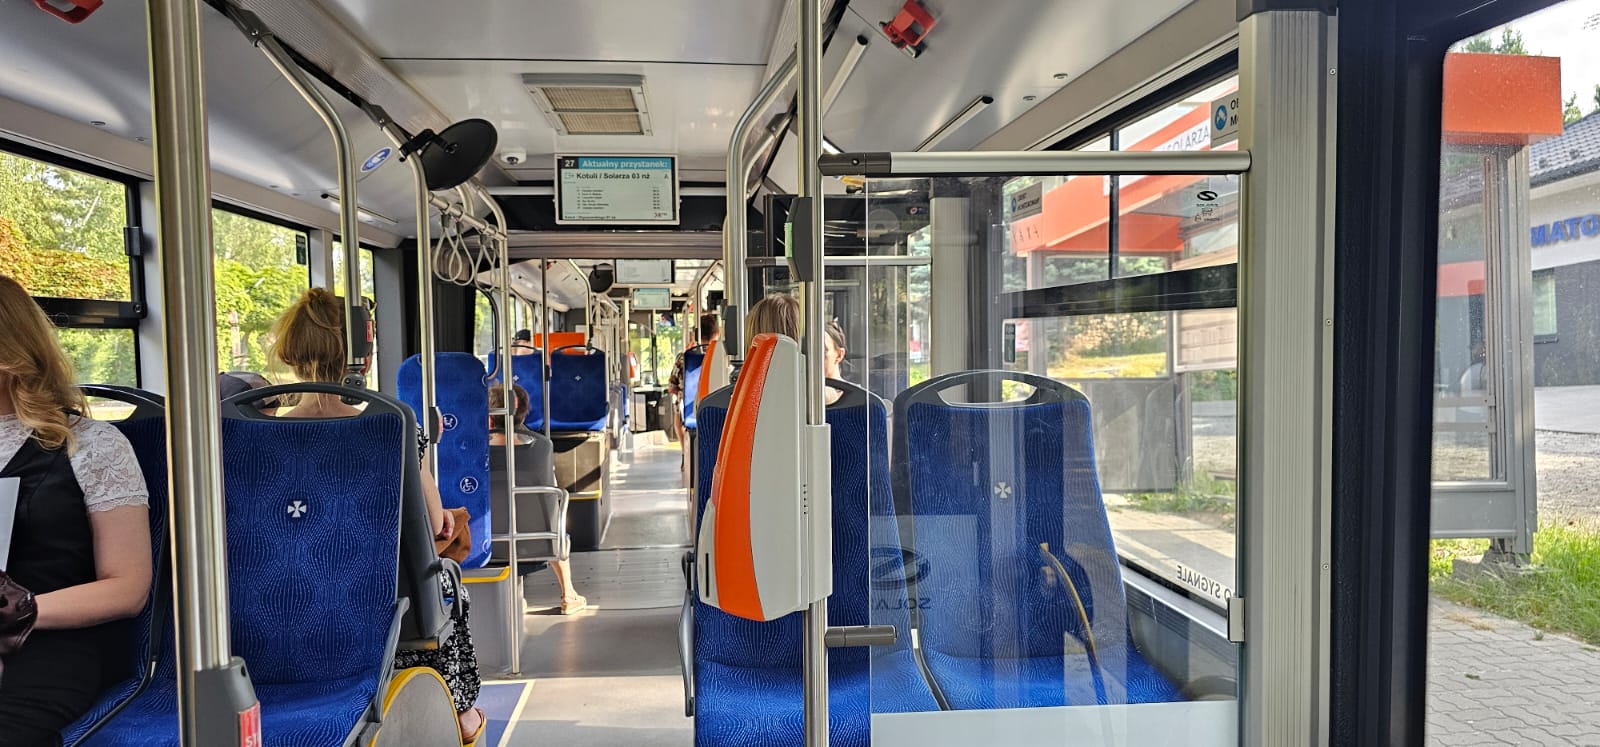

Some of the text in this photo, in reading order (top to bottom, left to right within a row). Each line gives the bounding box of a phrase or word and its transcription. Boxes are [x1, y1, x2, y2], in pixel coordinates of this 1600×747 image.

[564, 160, 575, 168] 27
[582, 160, 668, 169] Aktualny przystanek:
